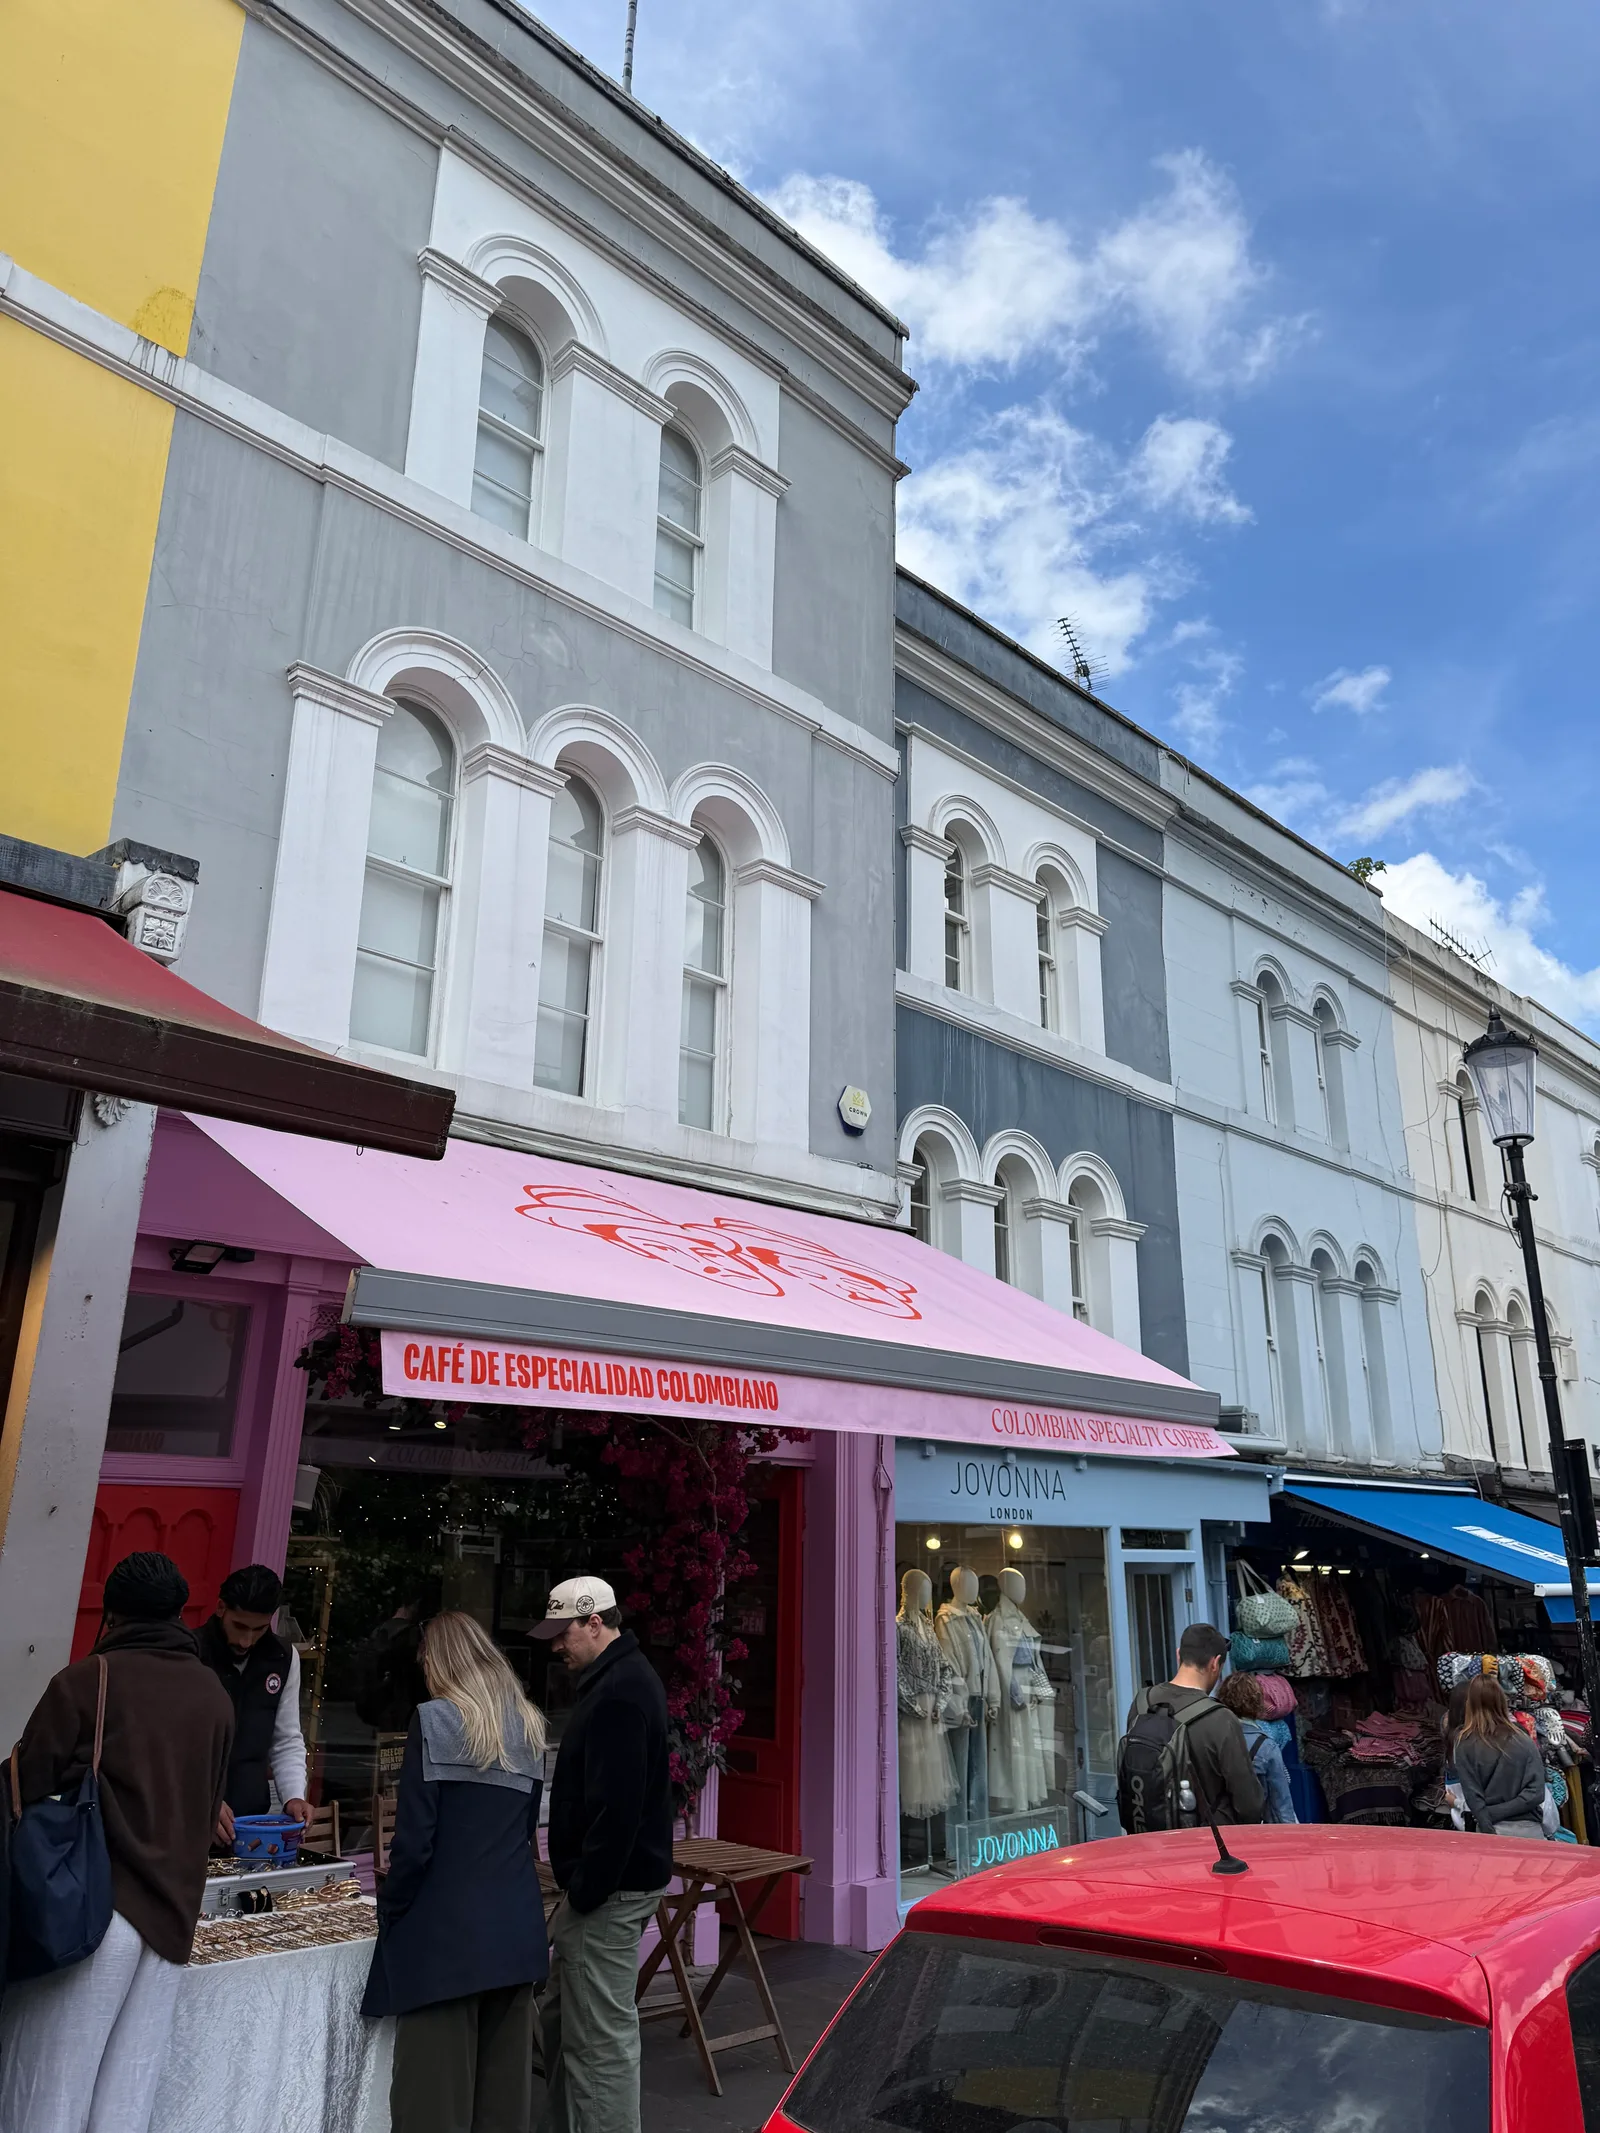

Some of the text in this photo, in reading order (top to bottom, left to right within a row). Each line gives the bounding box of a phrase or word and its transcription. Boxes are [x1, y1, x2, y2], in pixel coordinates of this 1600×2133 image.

[848, 1107, 868, 1117] CROWN
[404, 1342, 779, 1411] CAFÉ DE ESPECIALIDAD COLOMBIANO
[991, 1408, 1219, 1450] COLOMBIAN SPECIALTY COFFEE
[950, 1461, 1067, 1501] JOVONNA
[990, 1507, 1033, 1521] LONDON
[1295, 1512, 1324, 1528] THE
[738, 1616, 764, 1633] PEN
[971, 1823, 1059, 1867] JOVONNA
